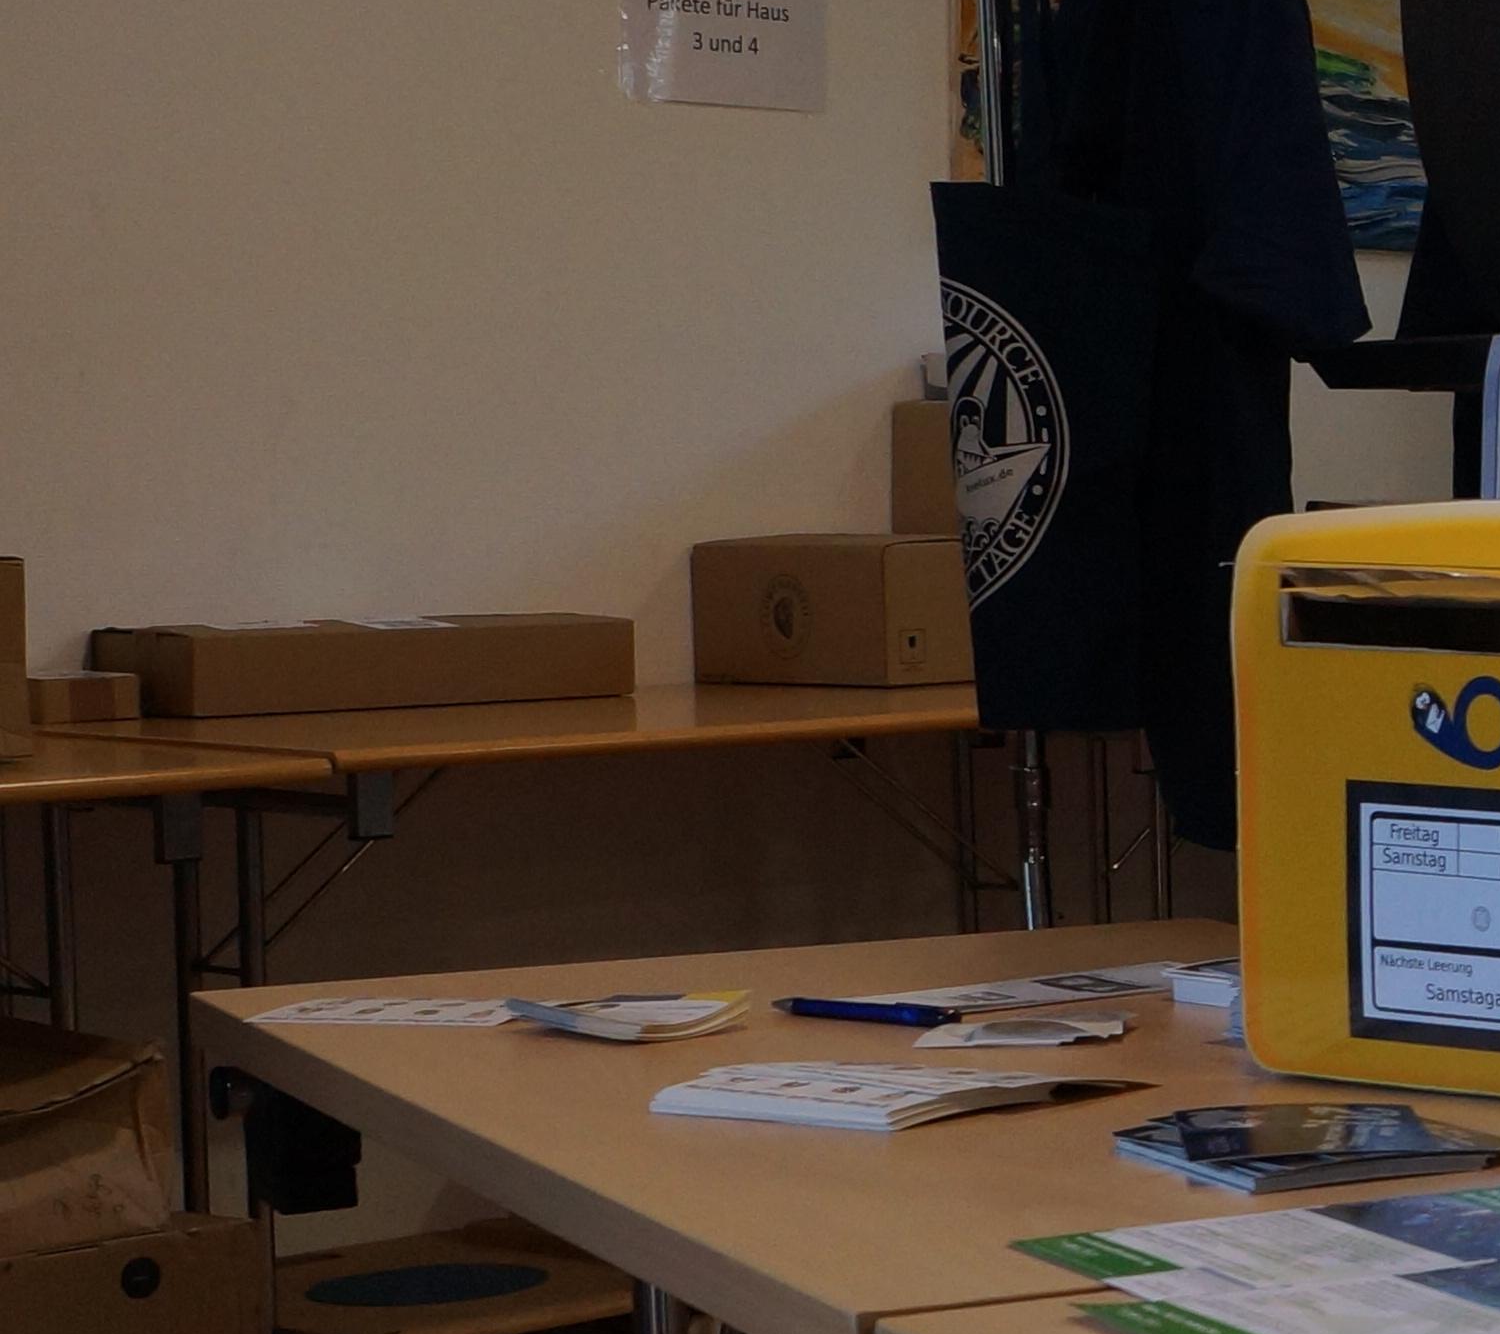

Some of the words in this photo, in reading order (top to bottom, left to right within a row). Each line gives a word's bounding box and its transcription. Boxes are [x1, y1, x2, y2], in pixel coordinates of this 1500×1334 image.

[746, 0, 789, 23] Haus
[692, 33, 703, 53] 3
[709, 33, 742, 55] und
[748, 35, 759, 56] 4
[942, 294, 1045, 392] OURCE
[1390, 823, 1439, 848] Freitag
[1382, 848, 1447, 872] Samstag
